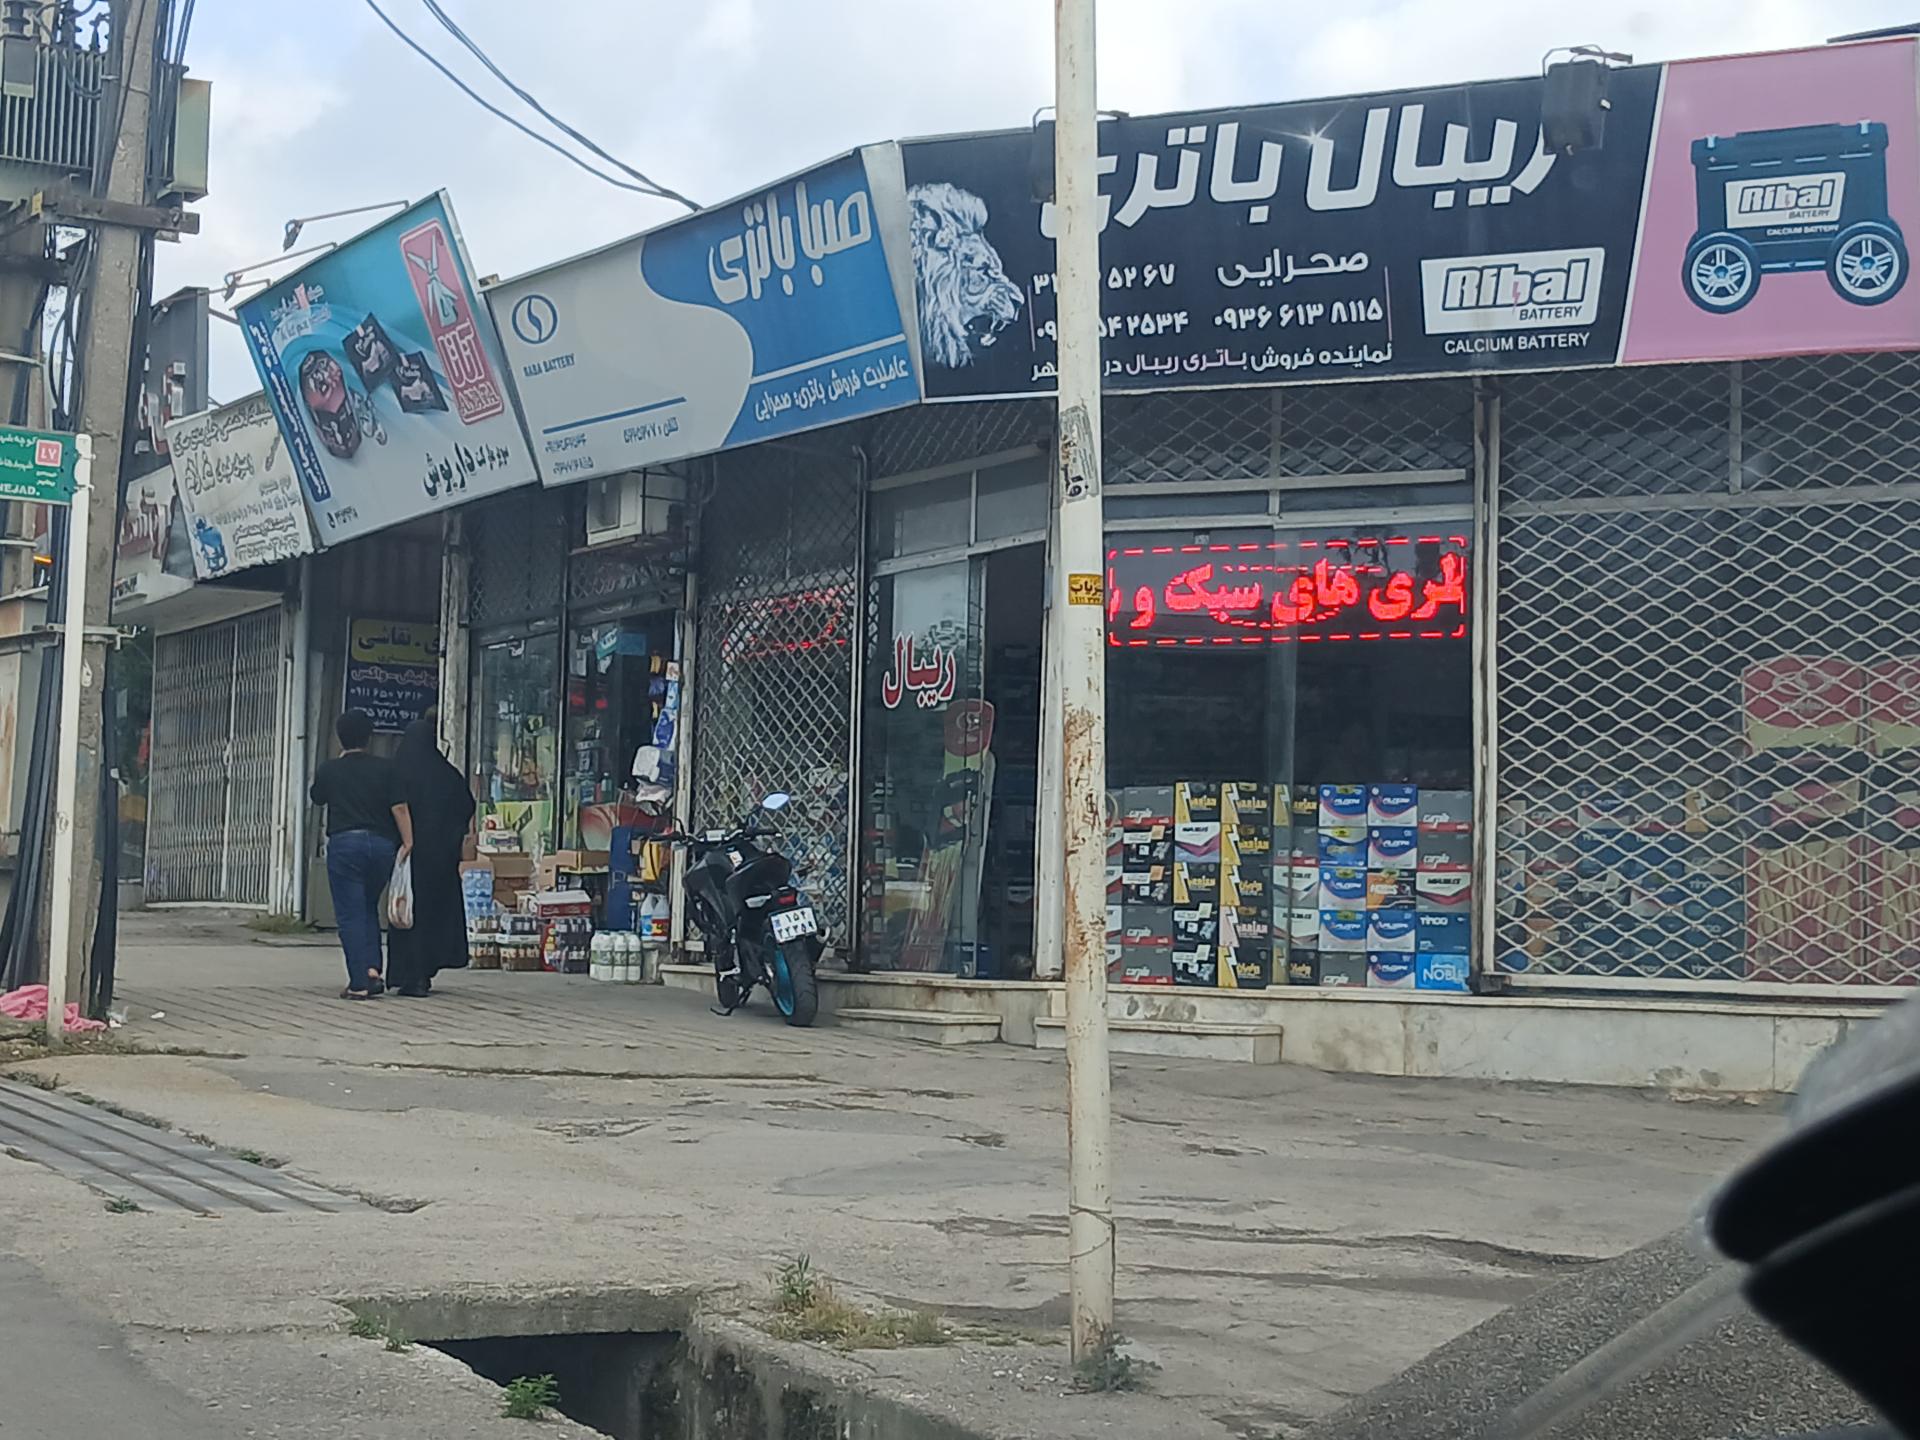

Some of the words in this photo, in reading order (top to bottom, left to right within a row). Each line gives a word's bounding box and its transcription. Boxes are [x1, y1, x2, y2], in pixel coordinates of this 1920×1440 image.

[1305, 103, 1557, 212] ریبال
[796, 180, 872, 288] صبا
[1217, 248, 1369, 287] صحرایی
[1519, 304, 1583, 322] BATTERY
[1319, 342, 1393, 368] نماینده
[1444, 335, 1514, 355] CALCIUM
[1518, 331, 1590, 352] BATTERY
[863, 354, 909, 391] عاملیت
[1104, 360, 1123, 377] در
[1125, 353, 1179, 377] ریبال
[1182, 347, 1248, 374] باتری
[1250, 346, 1316, 373] فروش
[828, 368, 861, 402] فروش
[882, 631, 957, 710] ریبال
